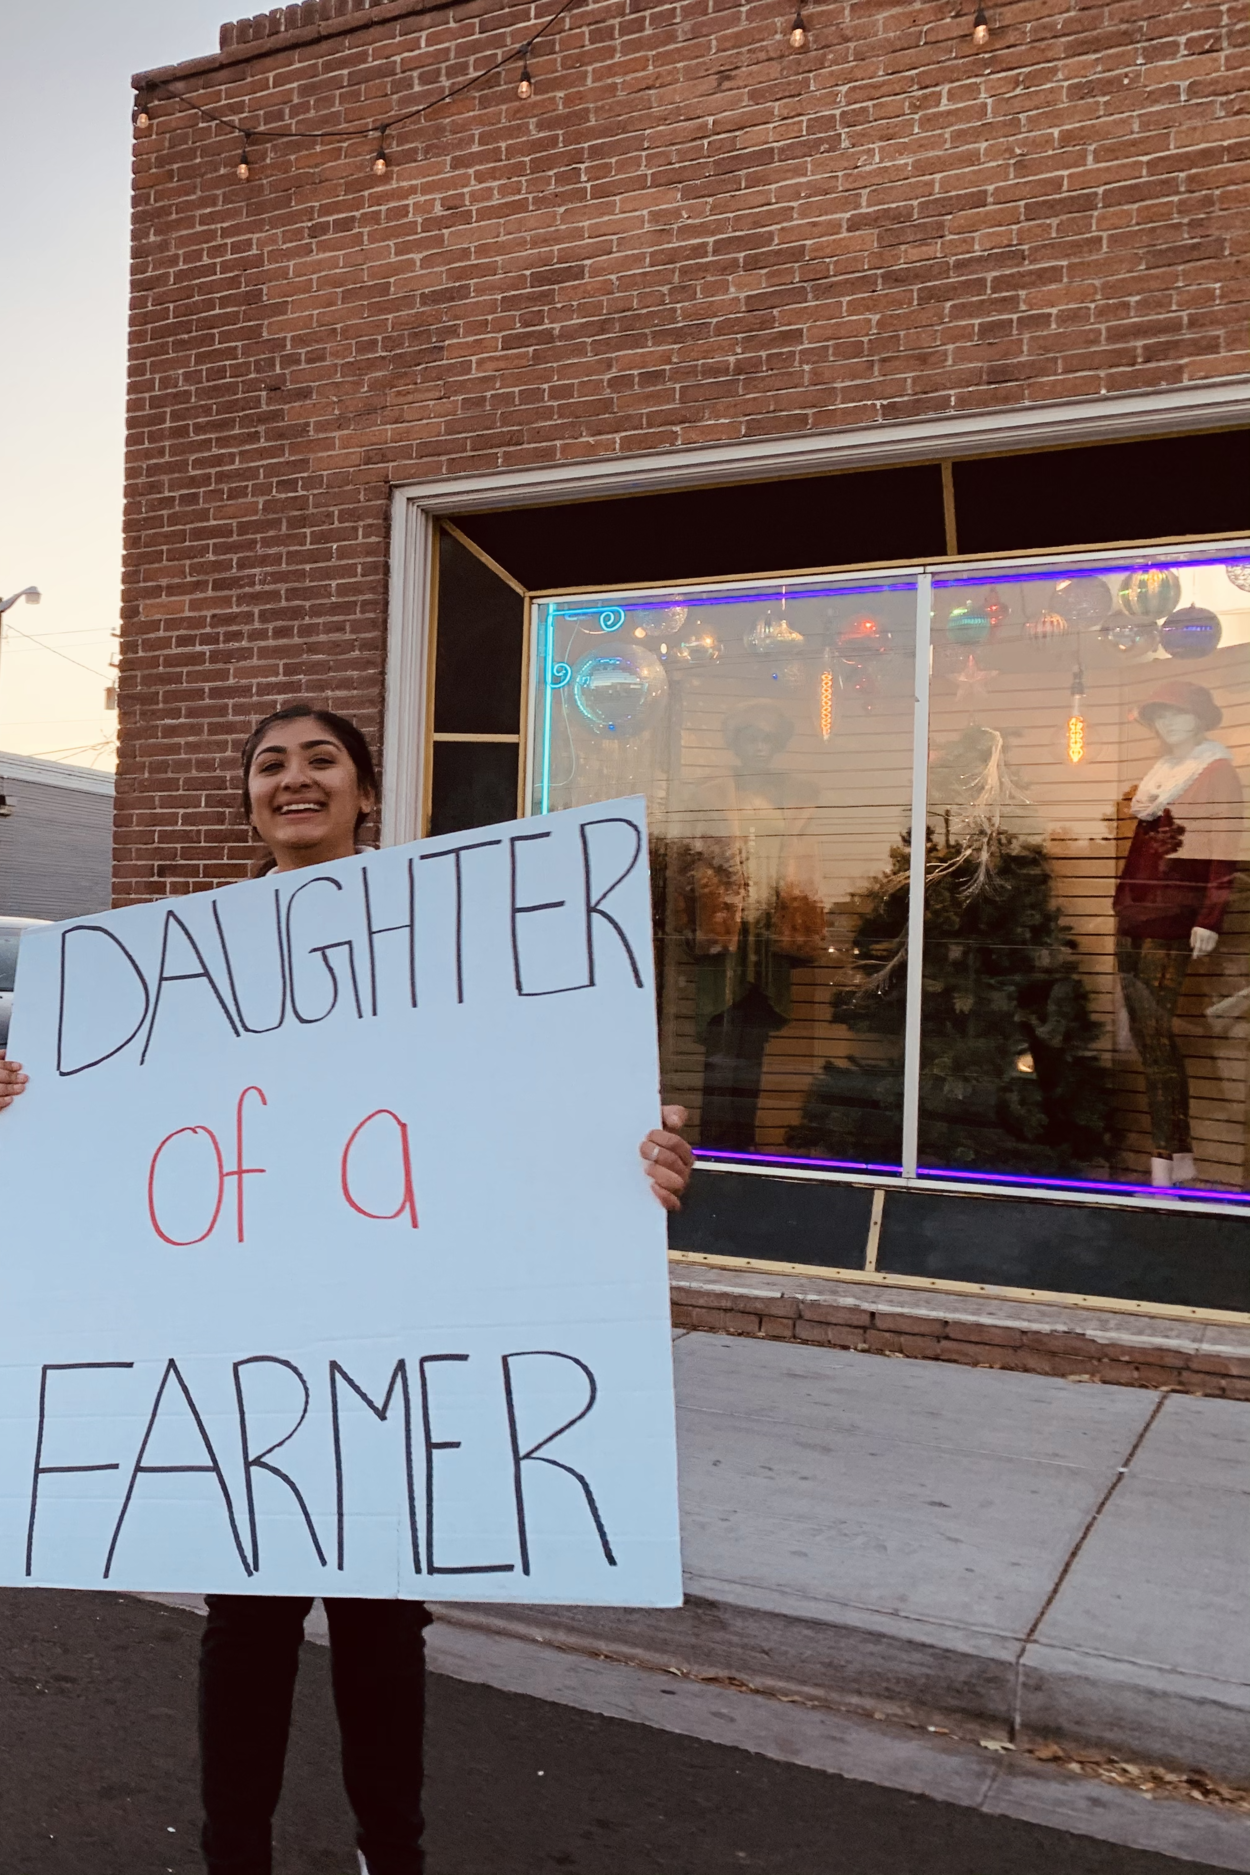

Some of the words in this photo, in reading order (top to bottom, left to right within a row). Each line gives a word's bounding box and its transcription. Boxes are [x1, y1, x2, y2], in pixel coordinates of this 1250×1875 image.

[55, 817, 644, 1077] DAUGHTER
[341, 1109, 420, 1229] a
[25, 1351, 618, 1579] FARMER
